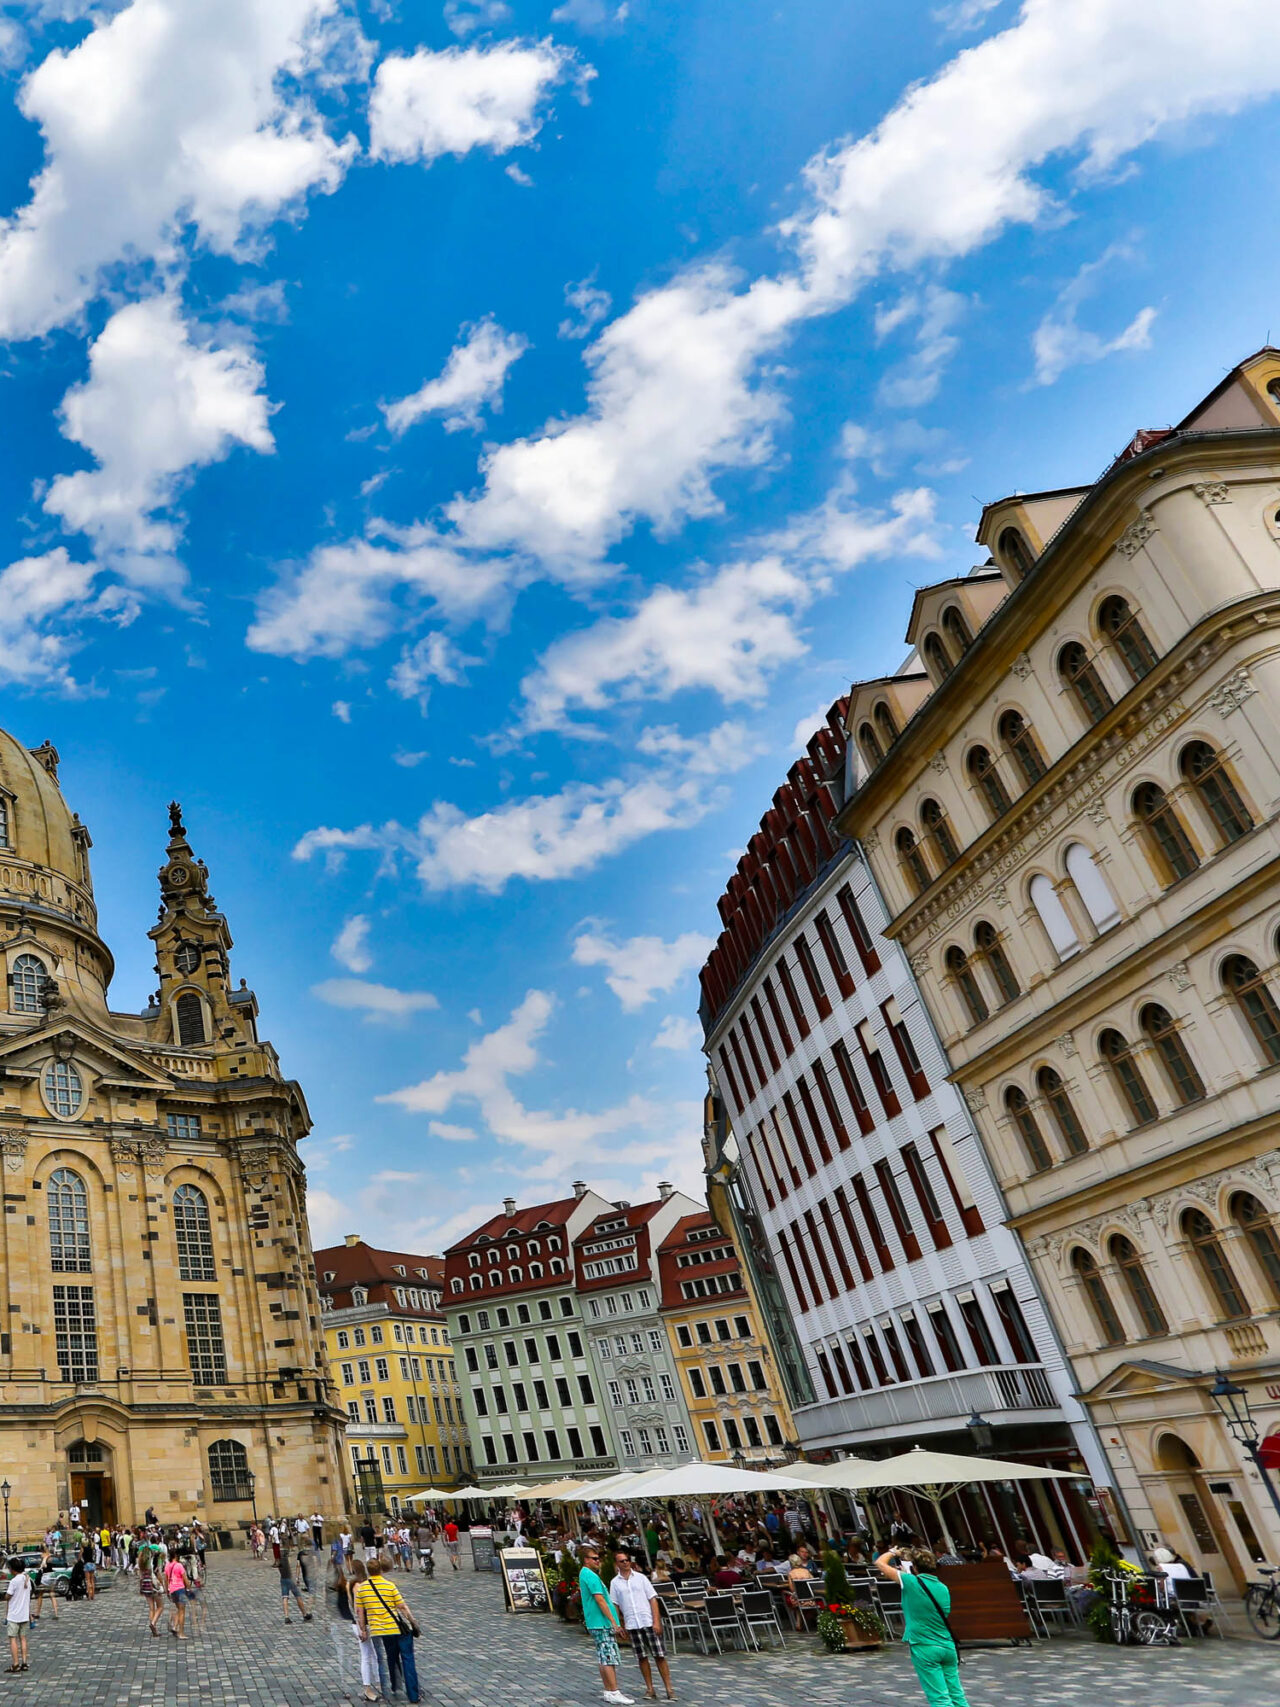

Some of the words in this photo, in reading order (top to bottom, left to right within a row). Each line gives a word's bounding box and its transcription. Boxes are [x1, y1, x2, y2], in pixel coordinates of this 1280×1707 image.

[927, 920, 941, 938] AN
[946, 882, 984, 919] GOTTES
[990, 842, 1027, 880] SEGEN
[1034, 816, 1055, 840] IST
[1065, 771, 1106, 815] ALLES
[1115, 697, 1186, 767] GELEGEN
[575, 1461, 614, 1470] MAREDO
[481, 1468, 517, 1476] MAREDO
